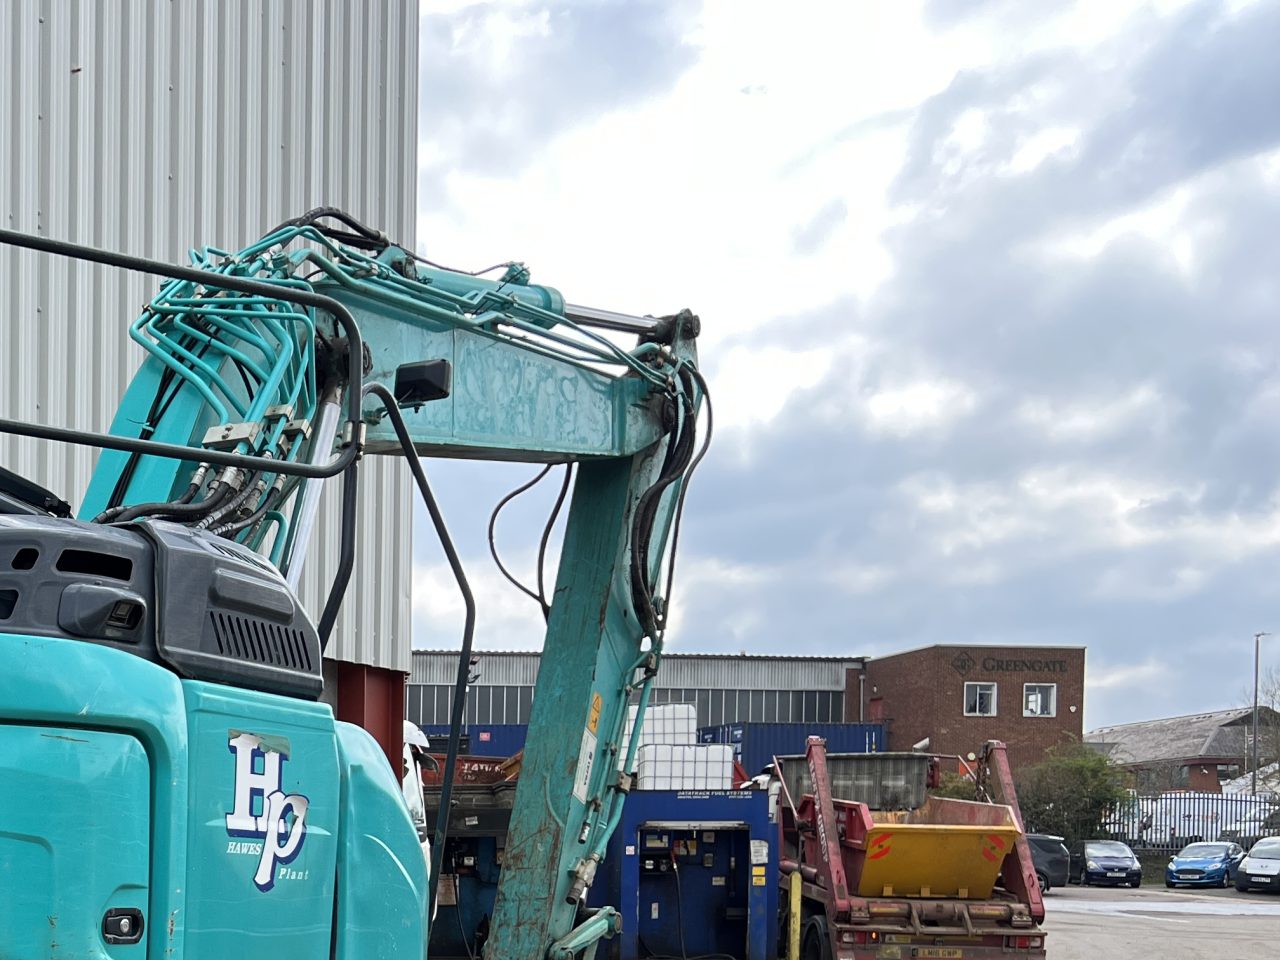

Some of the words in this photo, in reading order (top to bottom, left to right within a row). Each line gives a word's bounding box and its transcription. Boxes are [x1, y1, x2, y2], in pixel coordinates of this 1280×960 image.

[982, 657, 1068, 673] GREENGATE
[226, 841, 263, 856] HAWES
[278, 867, 309, 881] Plant
